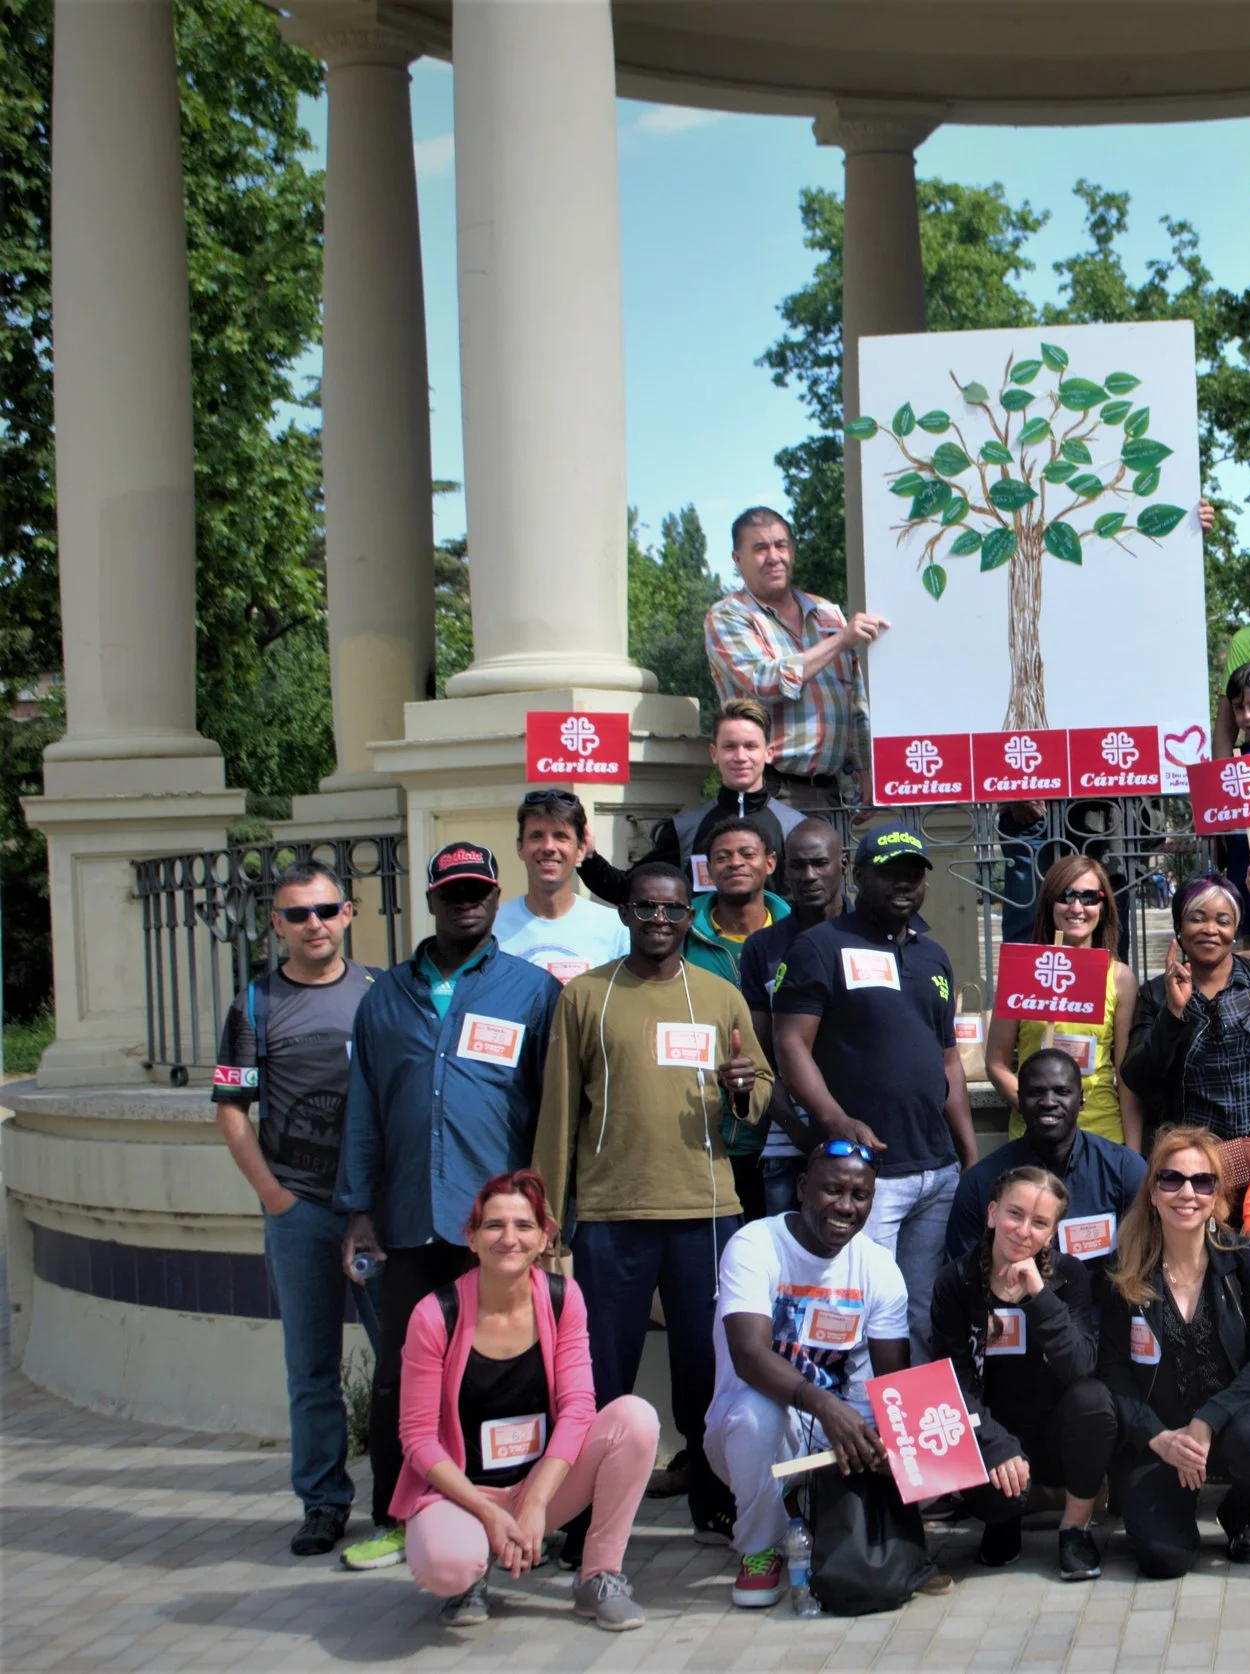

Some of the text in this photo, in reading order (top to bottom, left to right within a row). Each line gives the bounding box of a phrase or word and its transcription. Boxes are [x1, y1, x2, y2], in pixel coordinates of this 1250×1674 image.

[536, 757, 619, 774] Cáritas
[884, 780, 962, 796] Cáritas
[983, 776, 1061, 792] Cáritas
[1080, 773, 1158, 787] Cáritas
[877, 832, 922, 849] adidas
[1007, 994, 1094, 1013] Cáritas
[883, 1388, 923, 1486] Cáritas
